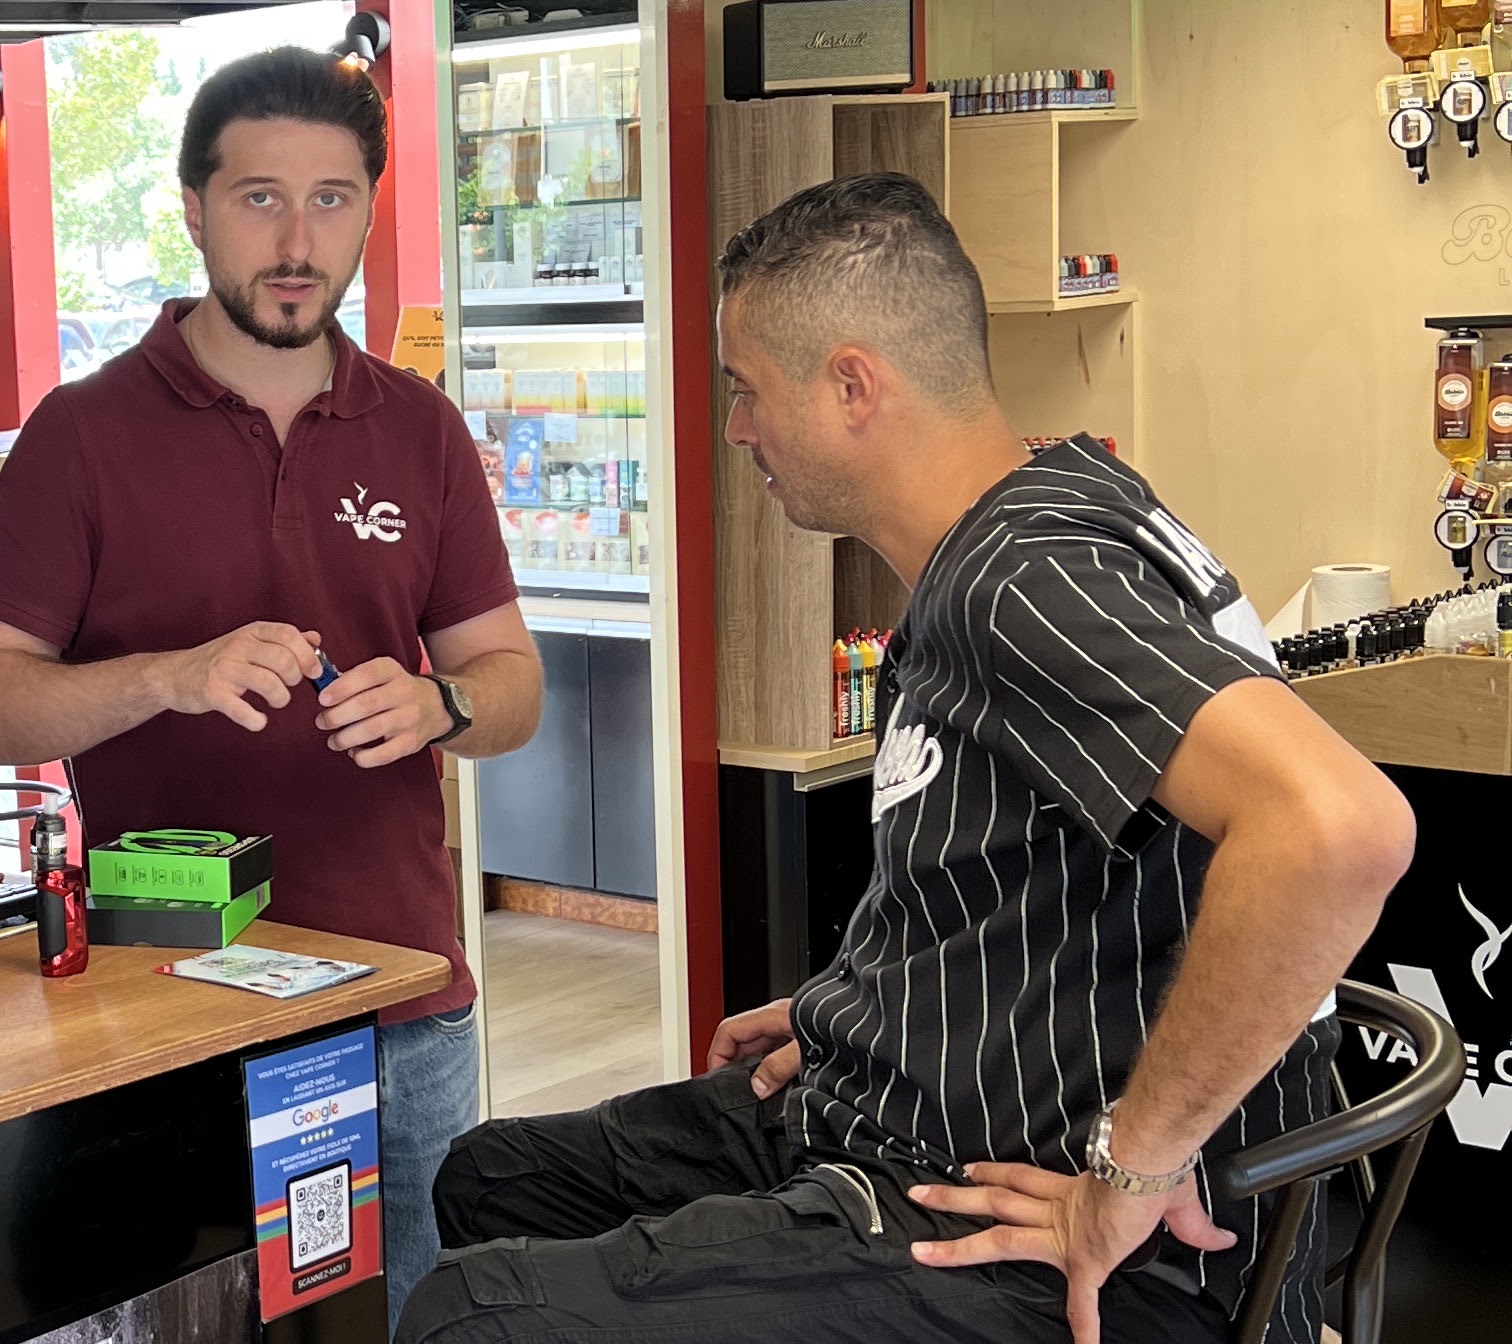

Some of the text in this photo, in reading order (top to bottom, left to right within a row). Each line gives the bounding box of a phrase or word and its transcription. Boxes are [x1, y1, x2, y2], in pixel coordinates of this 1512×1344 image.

[806, 30, 868, 49] Marshall
[334, 512, 407, 529] VAPE CORNER
[1358, 1026, 1479, 1077] VAE
[293, 1073, 336, 1094] AIDEZ-NOUS
[292, 1099, 339, 1127] Google
